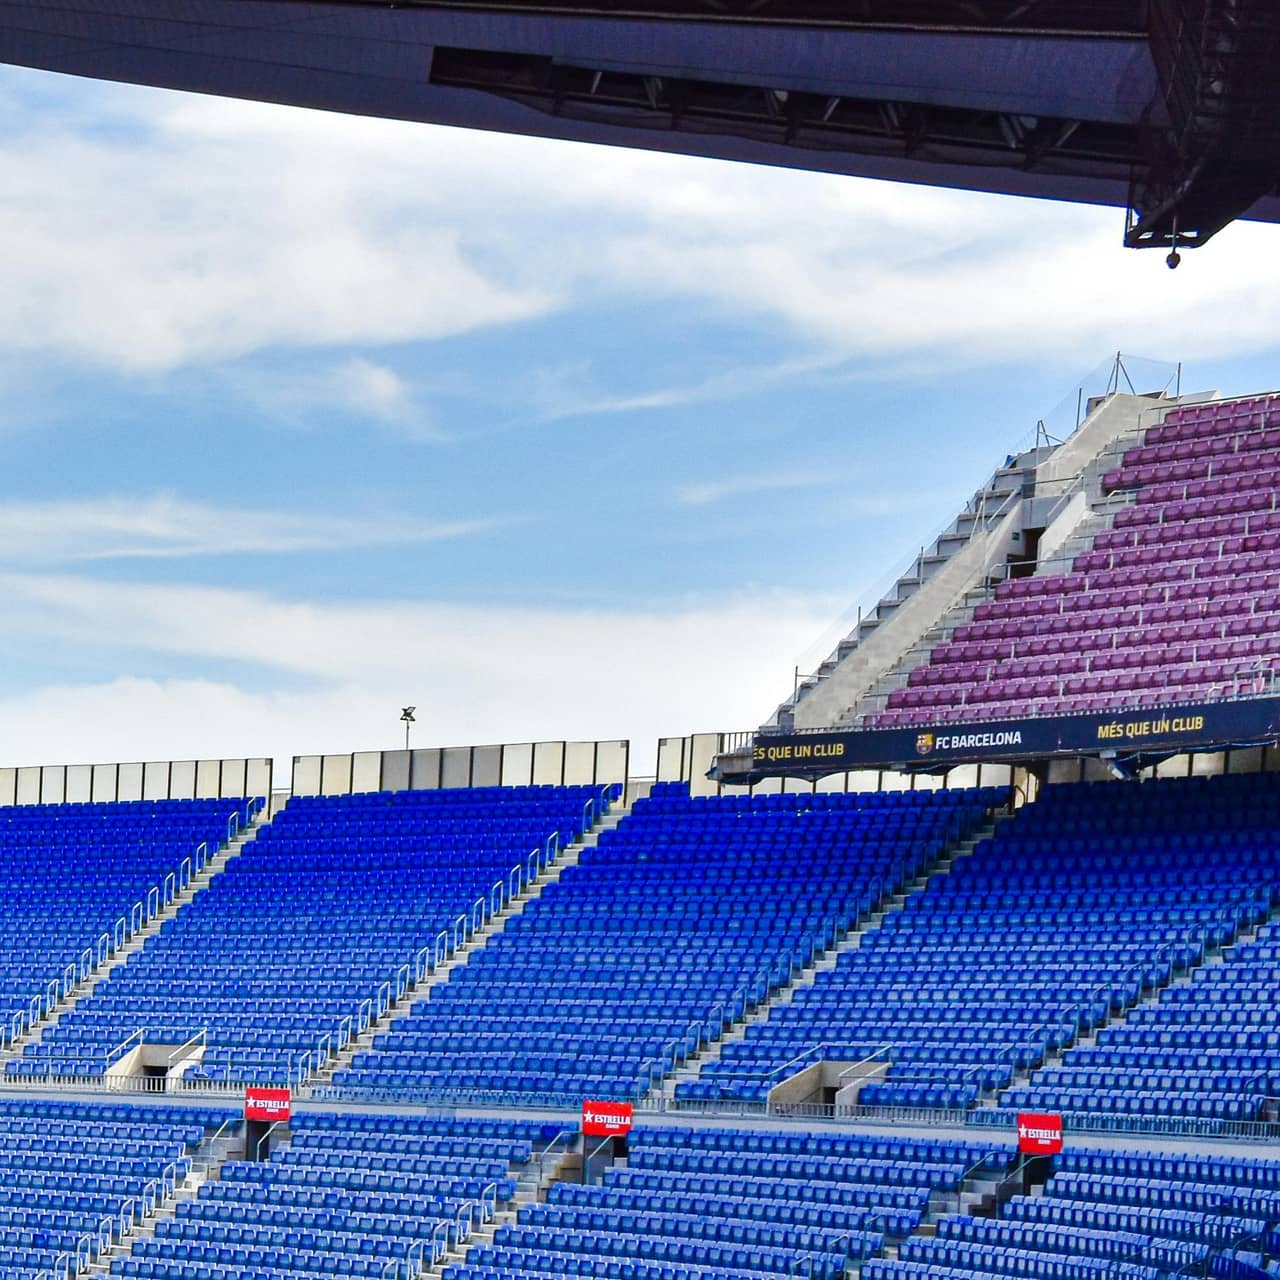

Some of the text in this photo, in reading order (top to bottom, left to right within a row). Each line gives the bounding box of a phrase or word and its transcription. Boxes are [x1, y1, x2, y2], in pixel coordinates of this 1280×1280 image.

[1098, 716, 1203, 738] MÉS QUE UN CLUB
[935, 731, 1022, 750] FC BARCELONA
[768, 746, 792, 761] QUE
[794, 745, 811, 757] UN
[814, 743, 844, 757] CLUB
[256, 1099, 289, 1109] ESTRELLA
[594, 1114, 631, 1125] ESTRELLA
[1028, 1128, 1061, 1140] ESTRELLA
